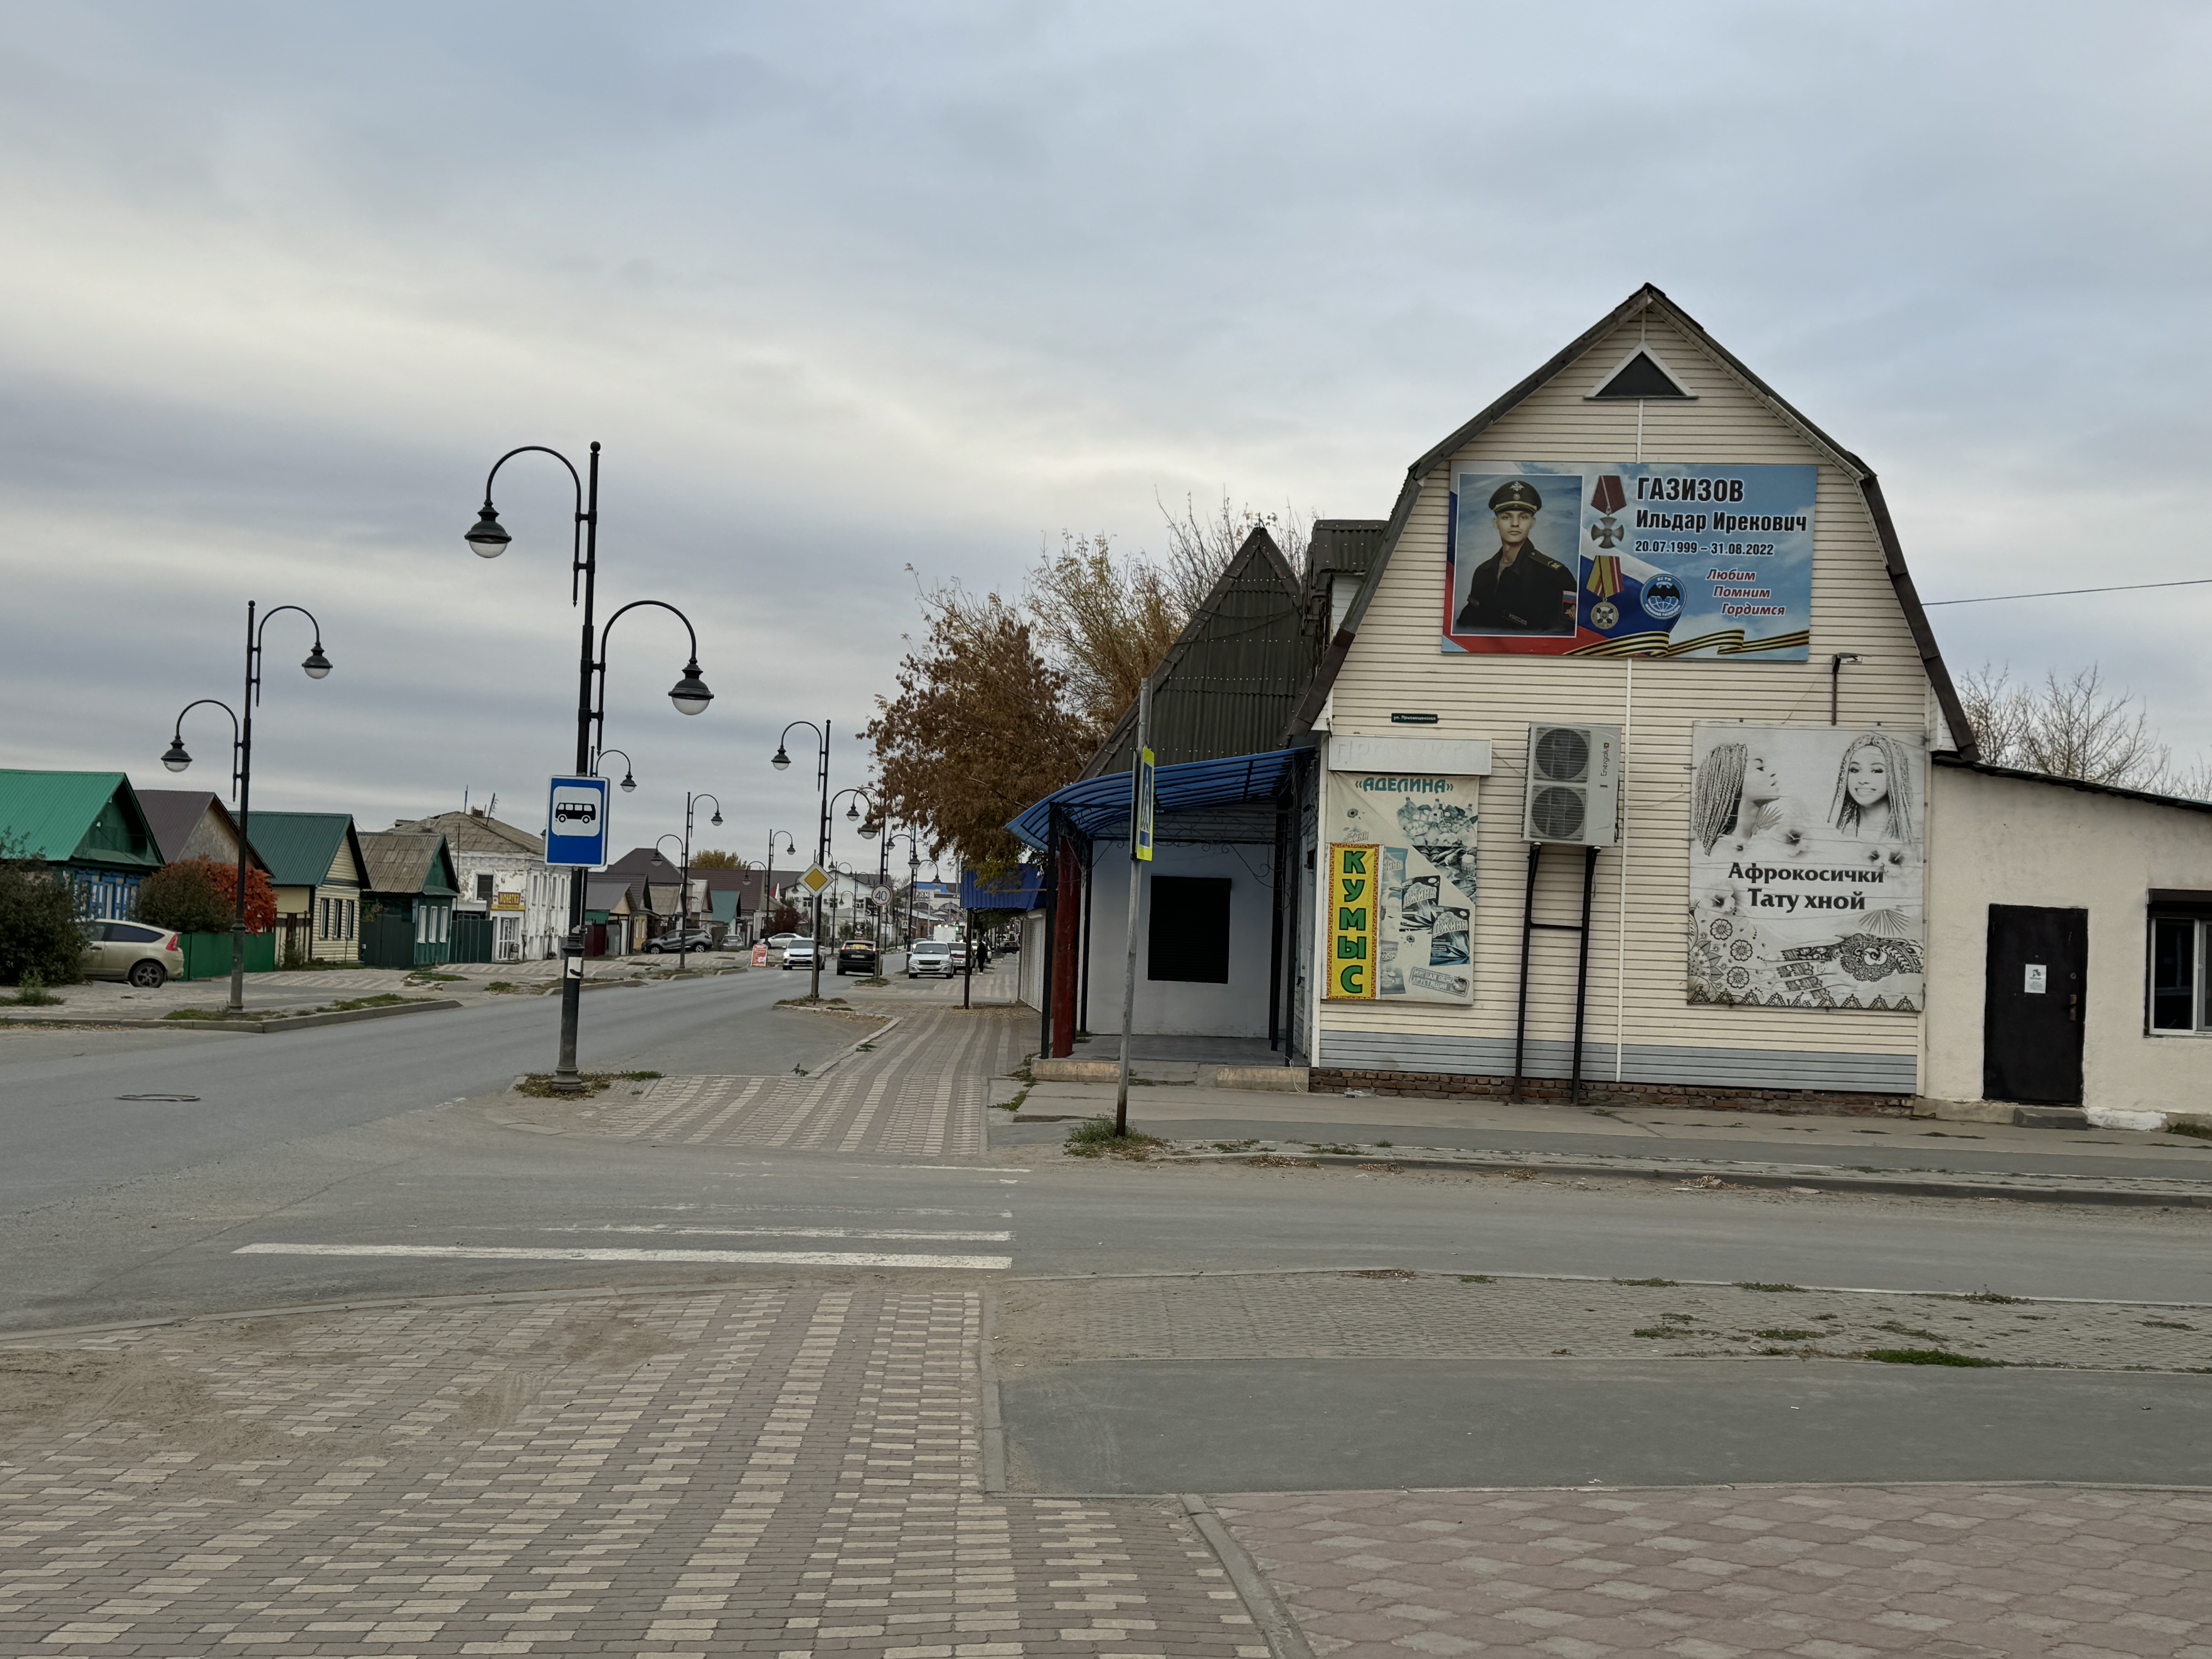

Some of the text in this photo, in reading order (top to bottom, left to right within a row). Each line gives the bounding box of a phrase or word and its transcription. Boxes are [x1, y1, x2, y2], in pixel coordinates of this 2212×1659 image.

[1638, 477, 1743, 502] ГАЗИЗОВ
[1636, 510, 1807, 534] Ильдар Ирекович
[1635, 541, 1697, 553] 20.07.1999
[1711, 543, 1774, 555] 31.08.2022
[1706, 569, 1755, 580] Любим
[1714, 586, 1770, 598] Помним
[1722, 603, 1785, 617] Гордимся
[1355, 777, 1454, 794] «АДЕЛИНА»
[1728, 862, 1884, 884] Афрокосички
[875, 891, 887, 901] 40
[1748, 888, 1865, 913] Тату хной
[1338, 850, 1367, 993] КУМЫС
[1433, 920, 1468, 938] ДЖИНН
